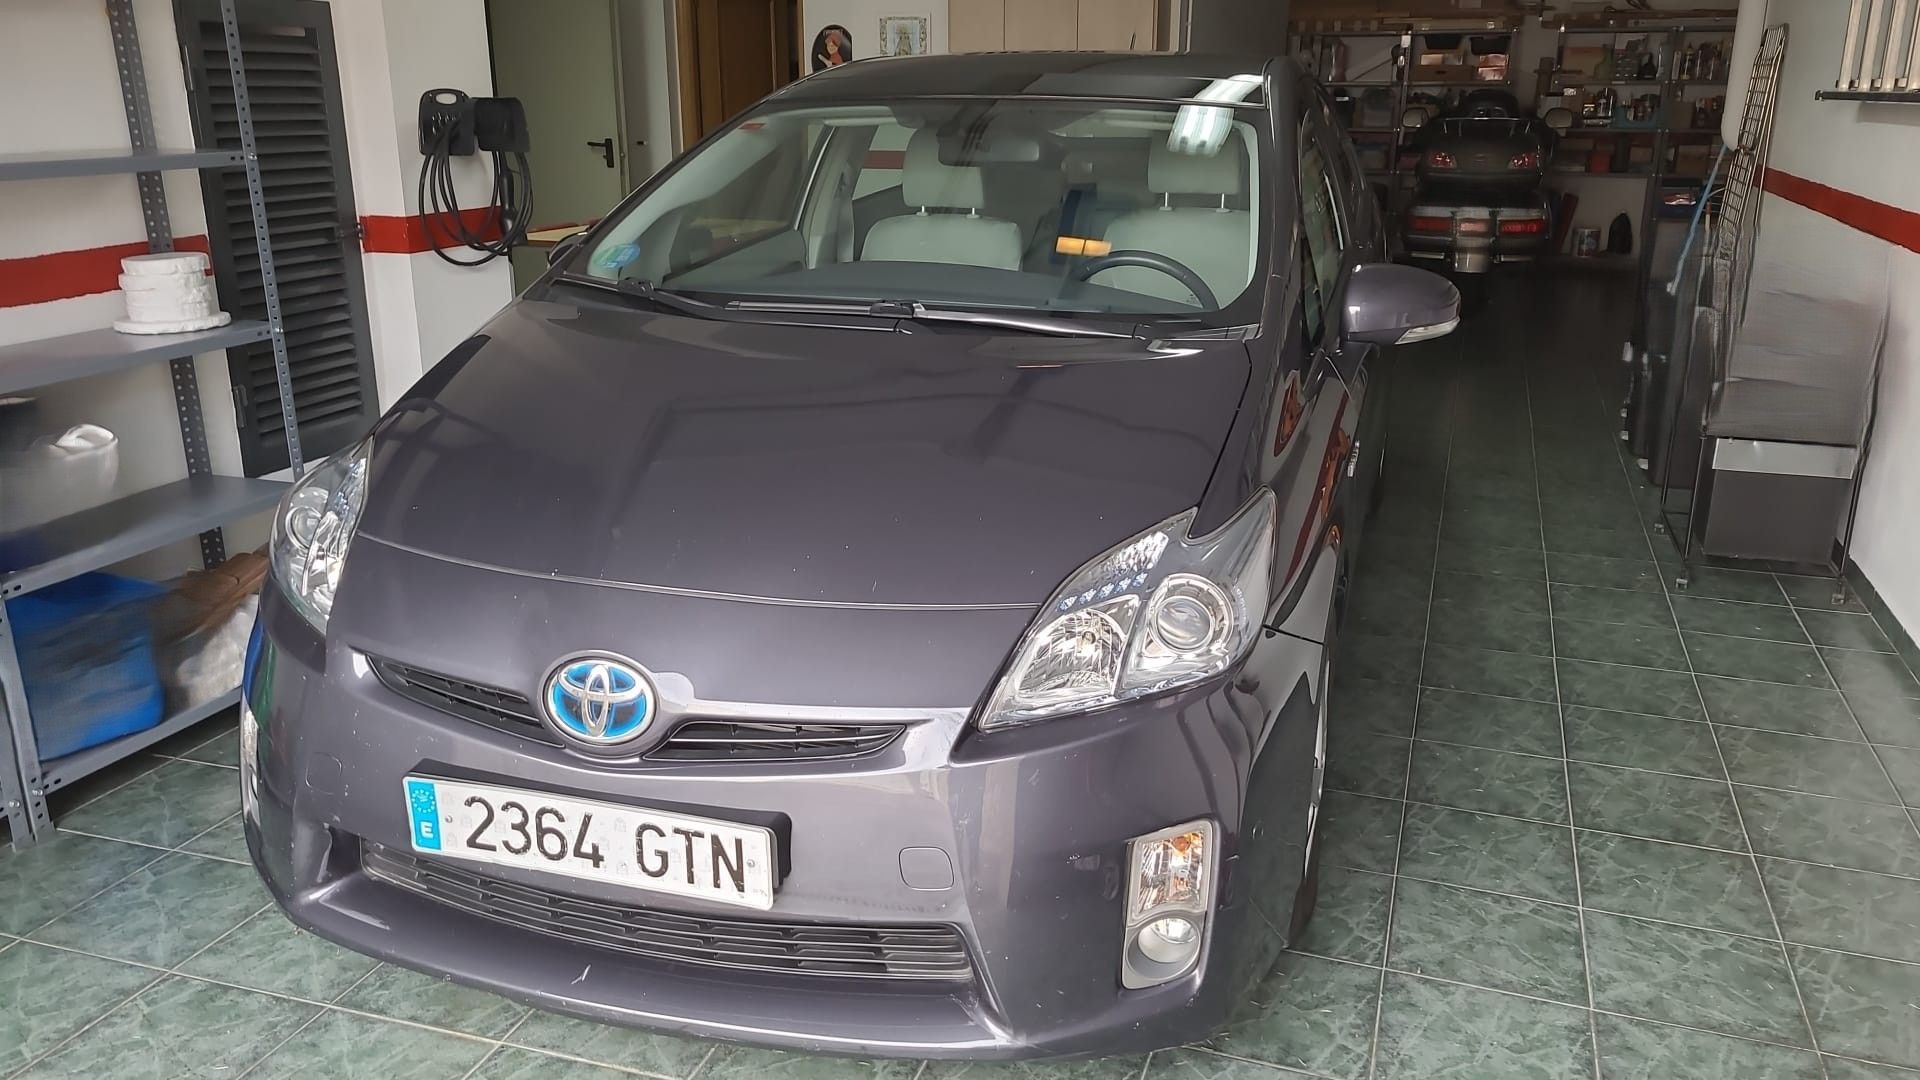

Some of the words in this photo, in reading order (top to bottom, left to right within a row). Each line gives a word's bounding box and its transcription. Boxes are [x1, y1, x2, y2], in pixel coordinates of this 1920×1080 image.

[420, 821, 434, 839] E
[464, 796, 604, 868] 2364
[635, 823, 745, 893] GTN
